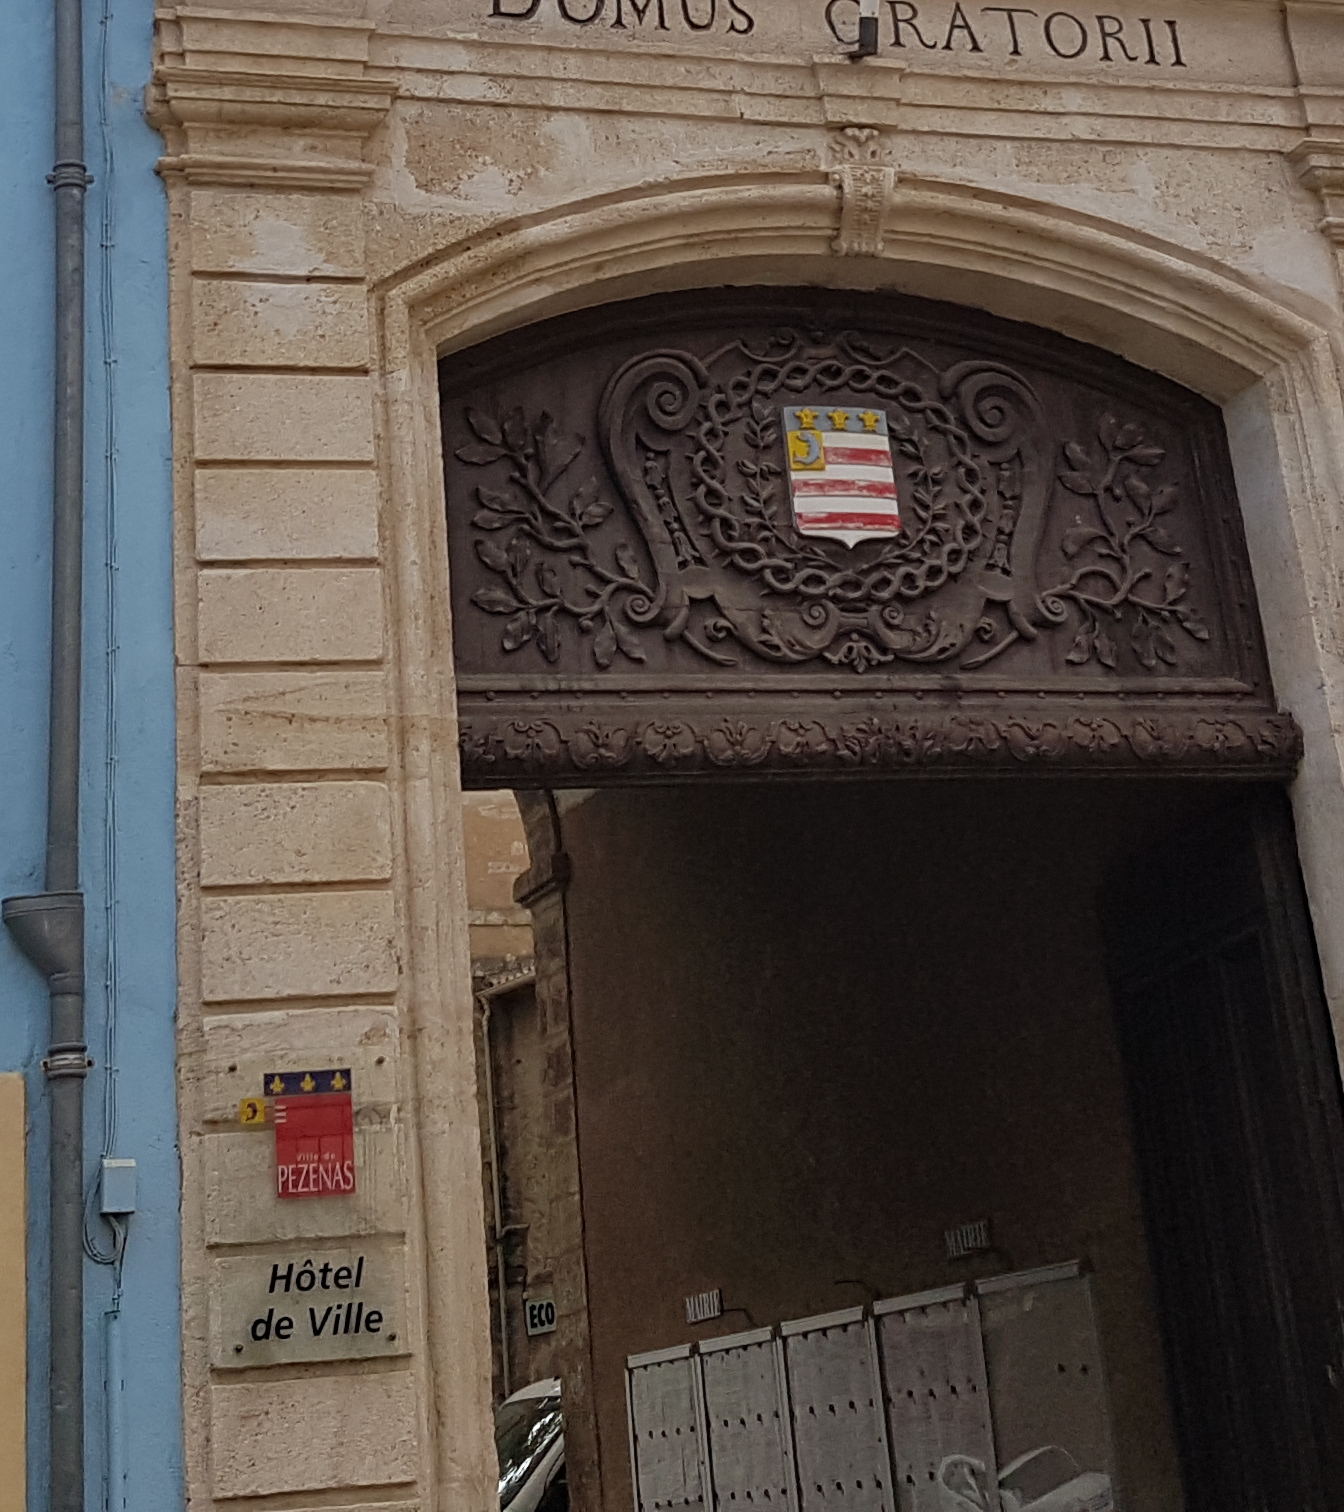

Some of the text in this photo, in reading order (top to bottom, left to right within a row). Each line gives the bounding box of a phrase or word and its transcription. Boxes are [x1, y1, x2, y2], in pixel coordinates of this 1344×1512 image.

[277, 1160, 354, 1194] PEZENAS
[267, 1255, 365, 1294] Hôtel
[250, 1301, 384, 1342] de Ville
[528, 1301, 555, 1329] ECO
[685, 1288, 722, 1321] MAIRIE
